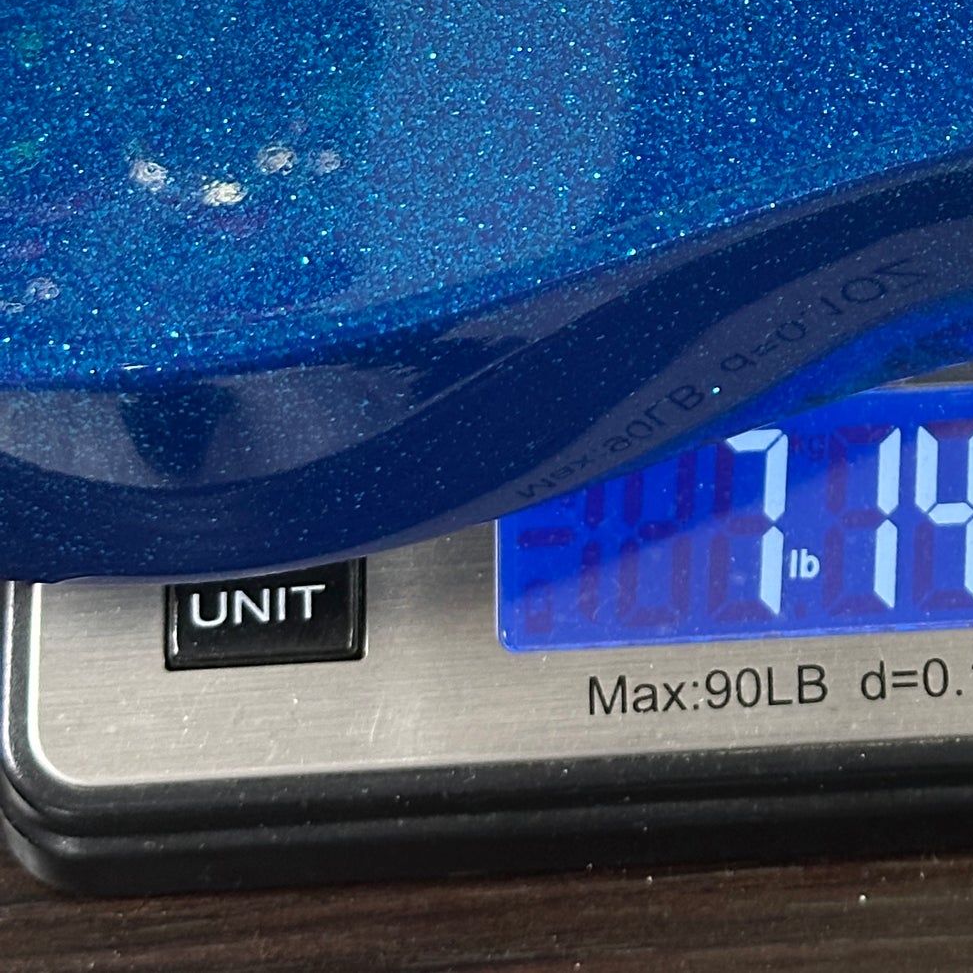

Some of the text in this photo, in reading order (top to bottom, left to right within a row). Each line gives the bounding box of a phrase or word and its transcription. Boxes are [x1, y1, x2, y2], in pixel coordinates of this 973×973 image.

[726, 428, 789, 616] 7
[789, 548, 821, 580] lb
[190, 583, 326, 628] UNIT
[588, 663, 829, 716] Max:90LB
